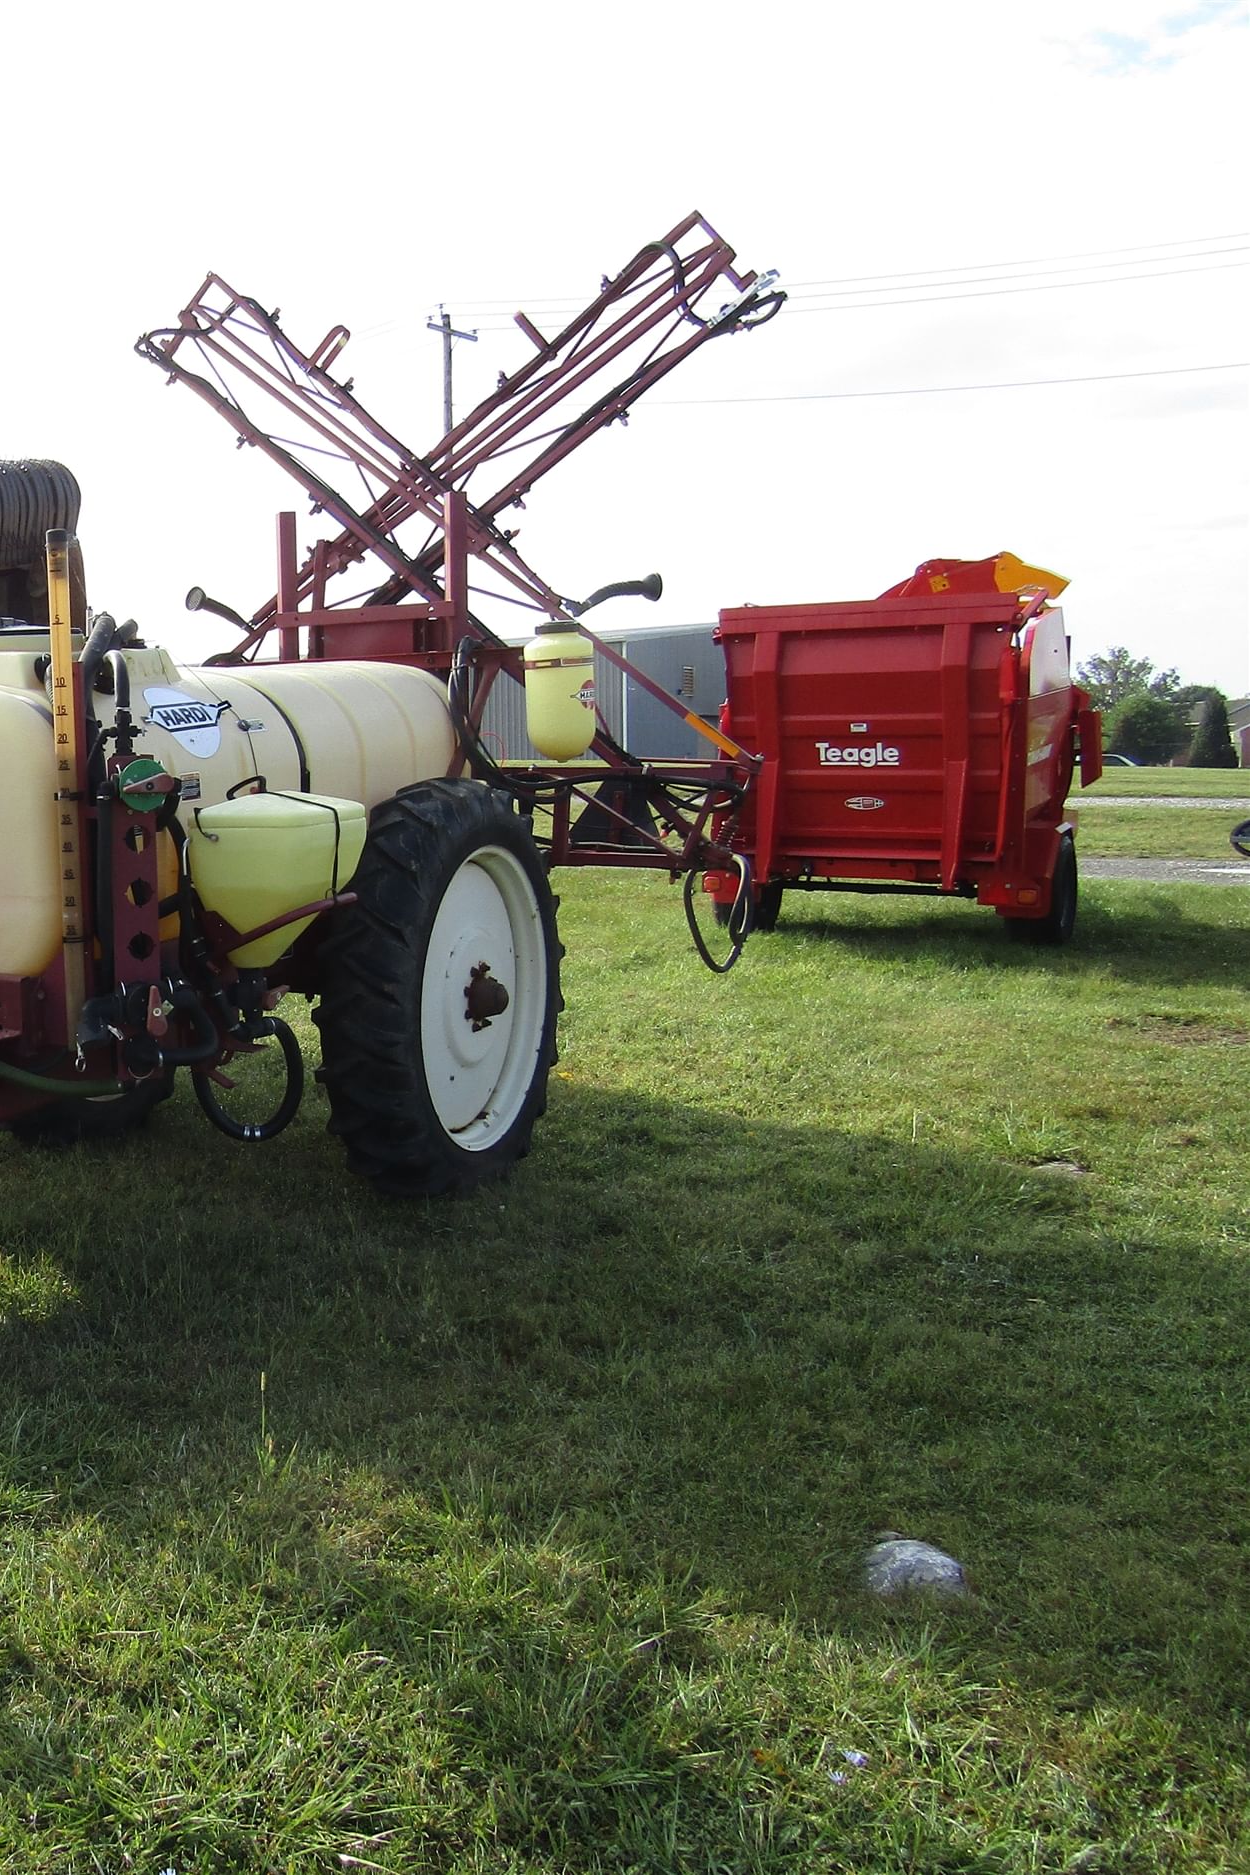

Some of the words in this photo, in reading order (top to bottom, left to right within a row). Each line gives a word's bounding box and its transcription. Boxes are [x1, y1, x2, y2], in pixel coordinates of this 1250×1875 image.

[55, 676, 65, 686] 10
[57, 704, 67, 714] 15
[156, 706, 213, 727] HARDI
[58, 733, 68, 742] 20
[815, 742, 900, 768] Teagle
[59, 759, 69, 769] 25
